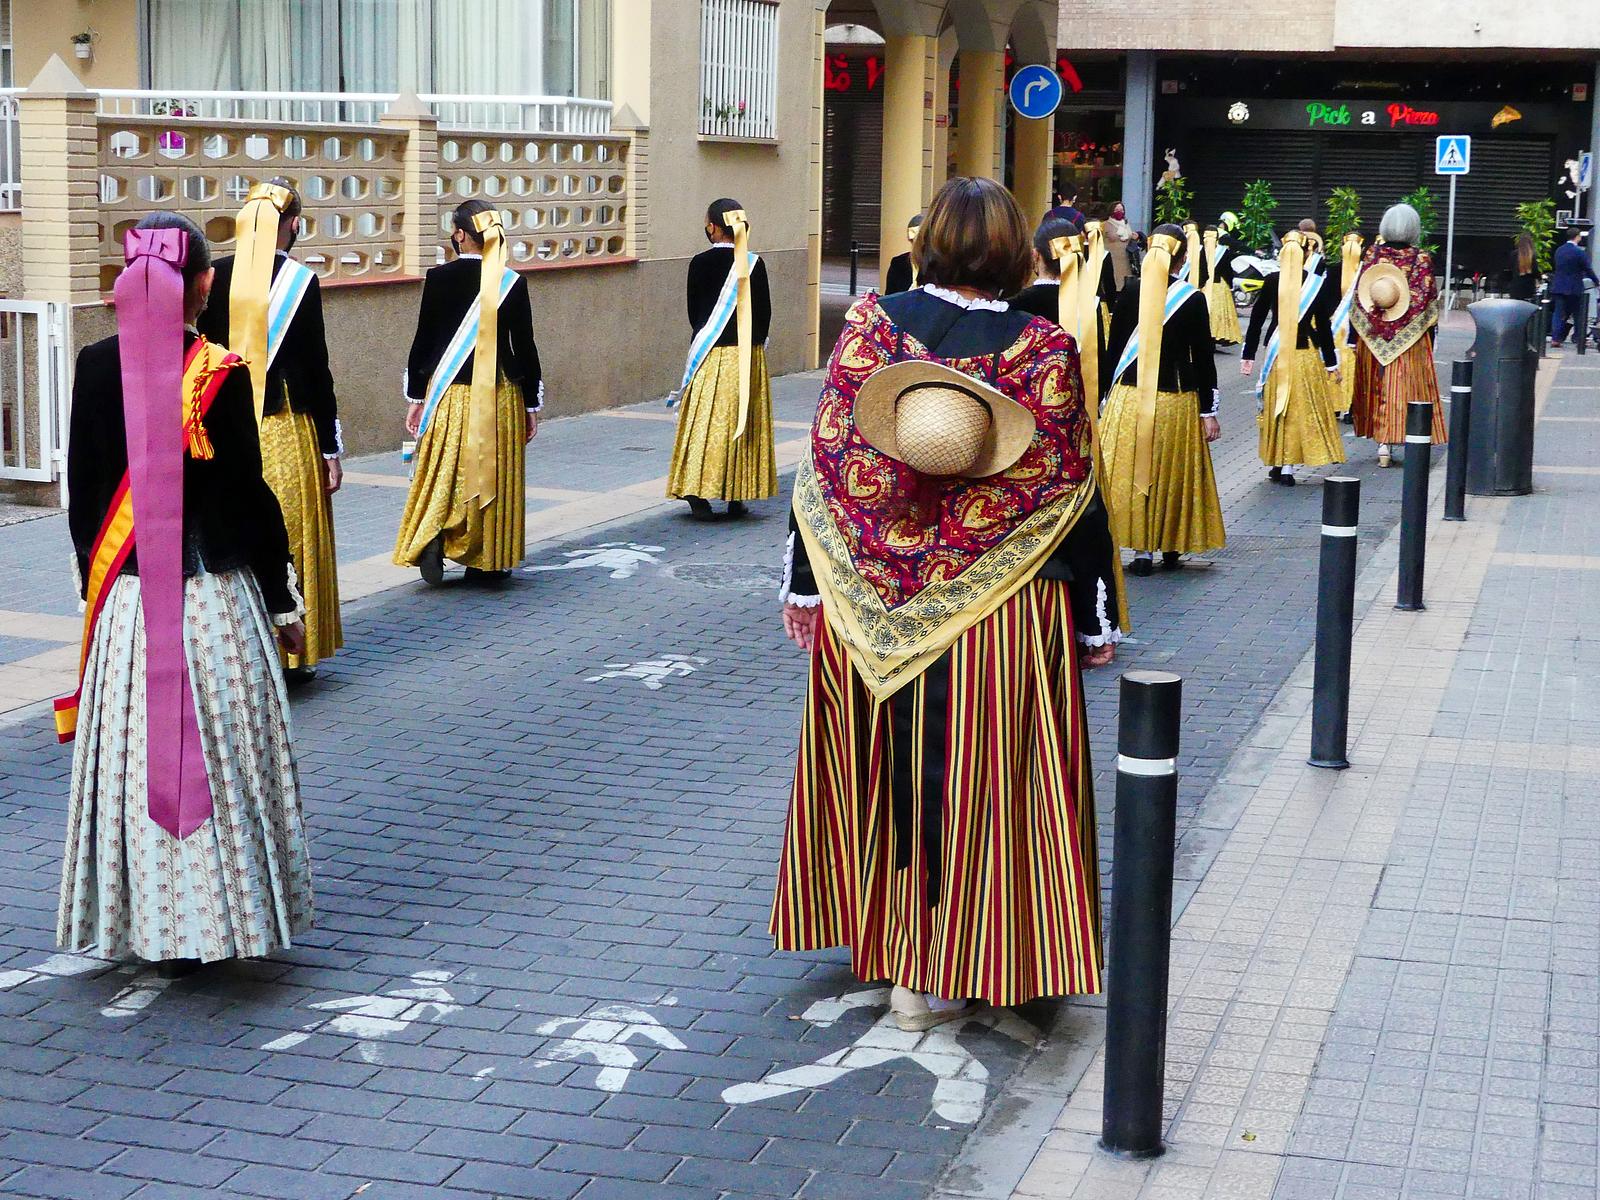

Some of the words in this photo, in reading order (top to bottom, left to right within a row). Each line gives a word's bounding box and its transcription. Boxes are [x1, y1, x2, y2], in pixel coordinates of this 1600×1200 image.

[1306, 102, 1351, 127] Pick
[1361, 110, 1376, 125] a
[1386, 102, 1440, 128] Pizza
